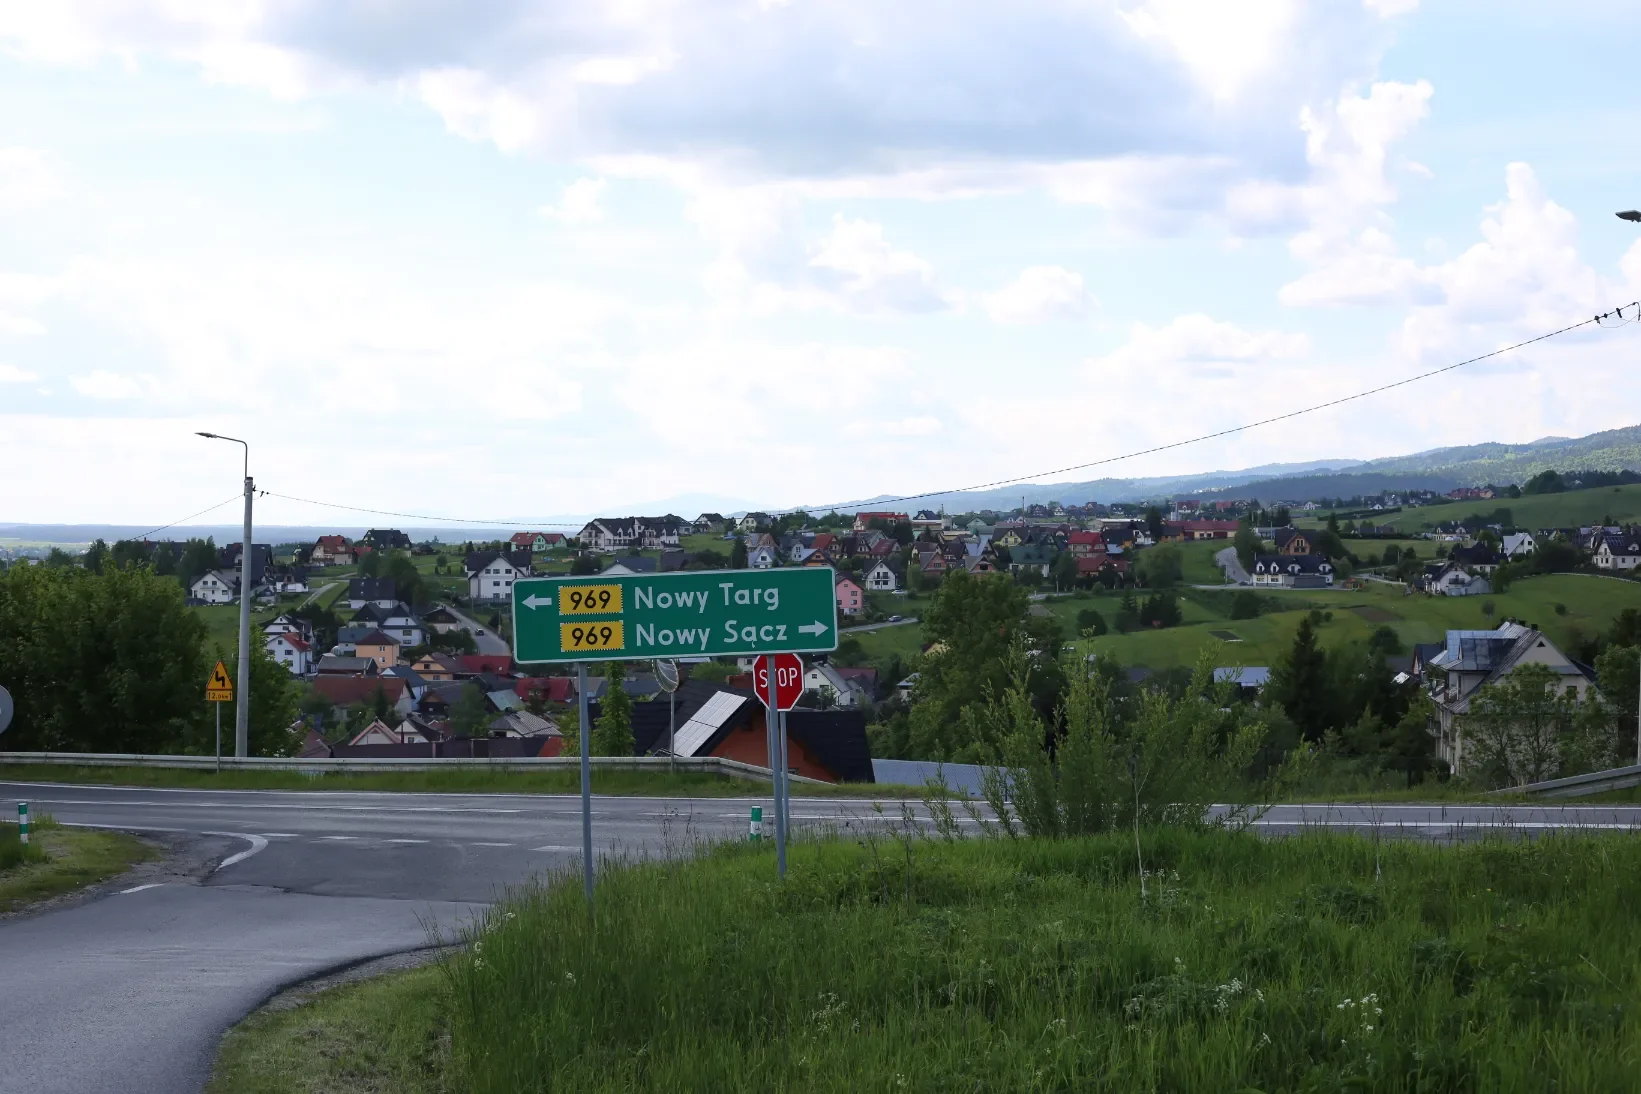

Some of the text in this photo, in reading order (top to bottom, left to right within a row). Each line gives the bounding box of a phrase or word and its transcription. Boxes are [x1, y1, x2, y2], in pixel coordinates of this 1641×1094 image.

[570, 582, 779, 614] 969 Nowy Targ
[571, 619, 788, 651] 969 Nowy Sącz
[759, 667, 798, 688] SOP
